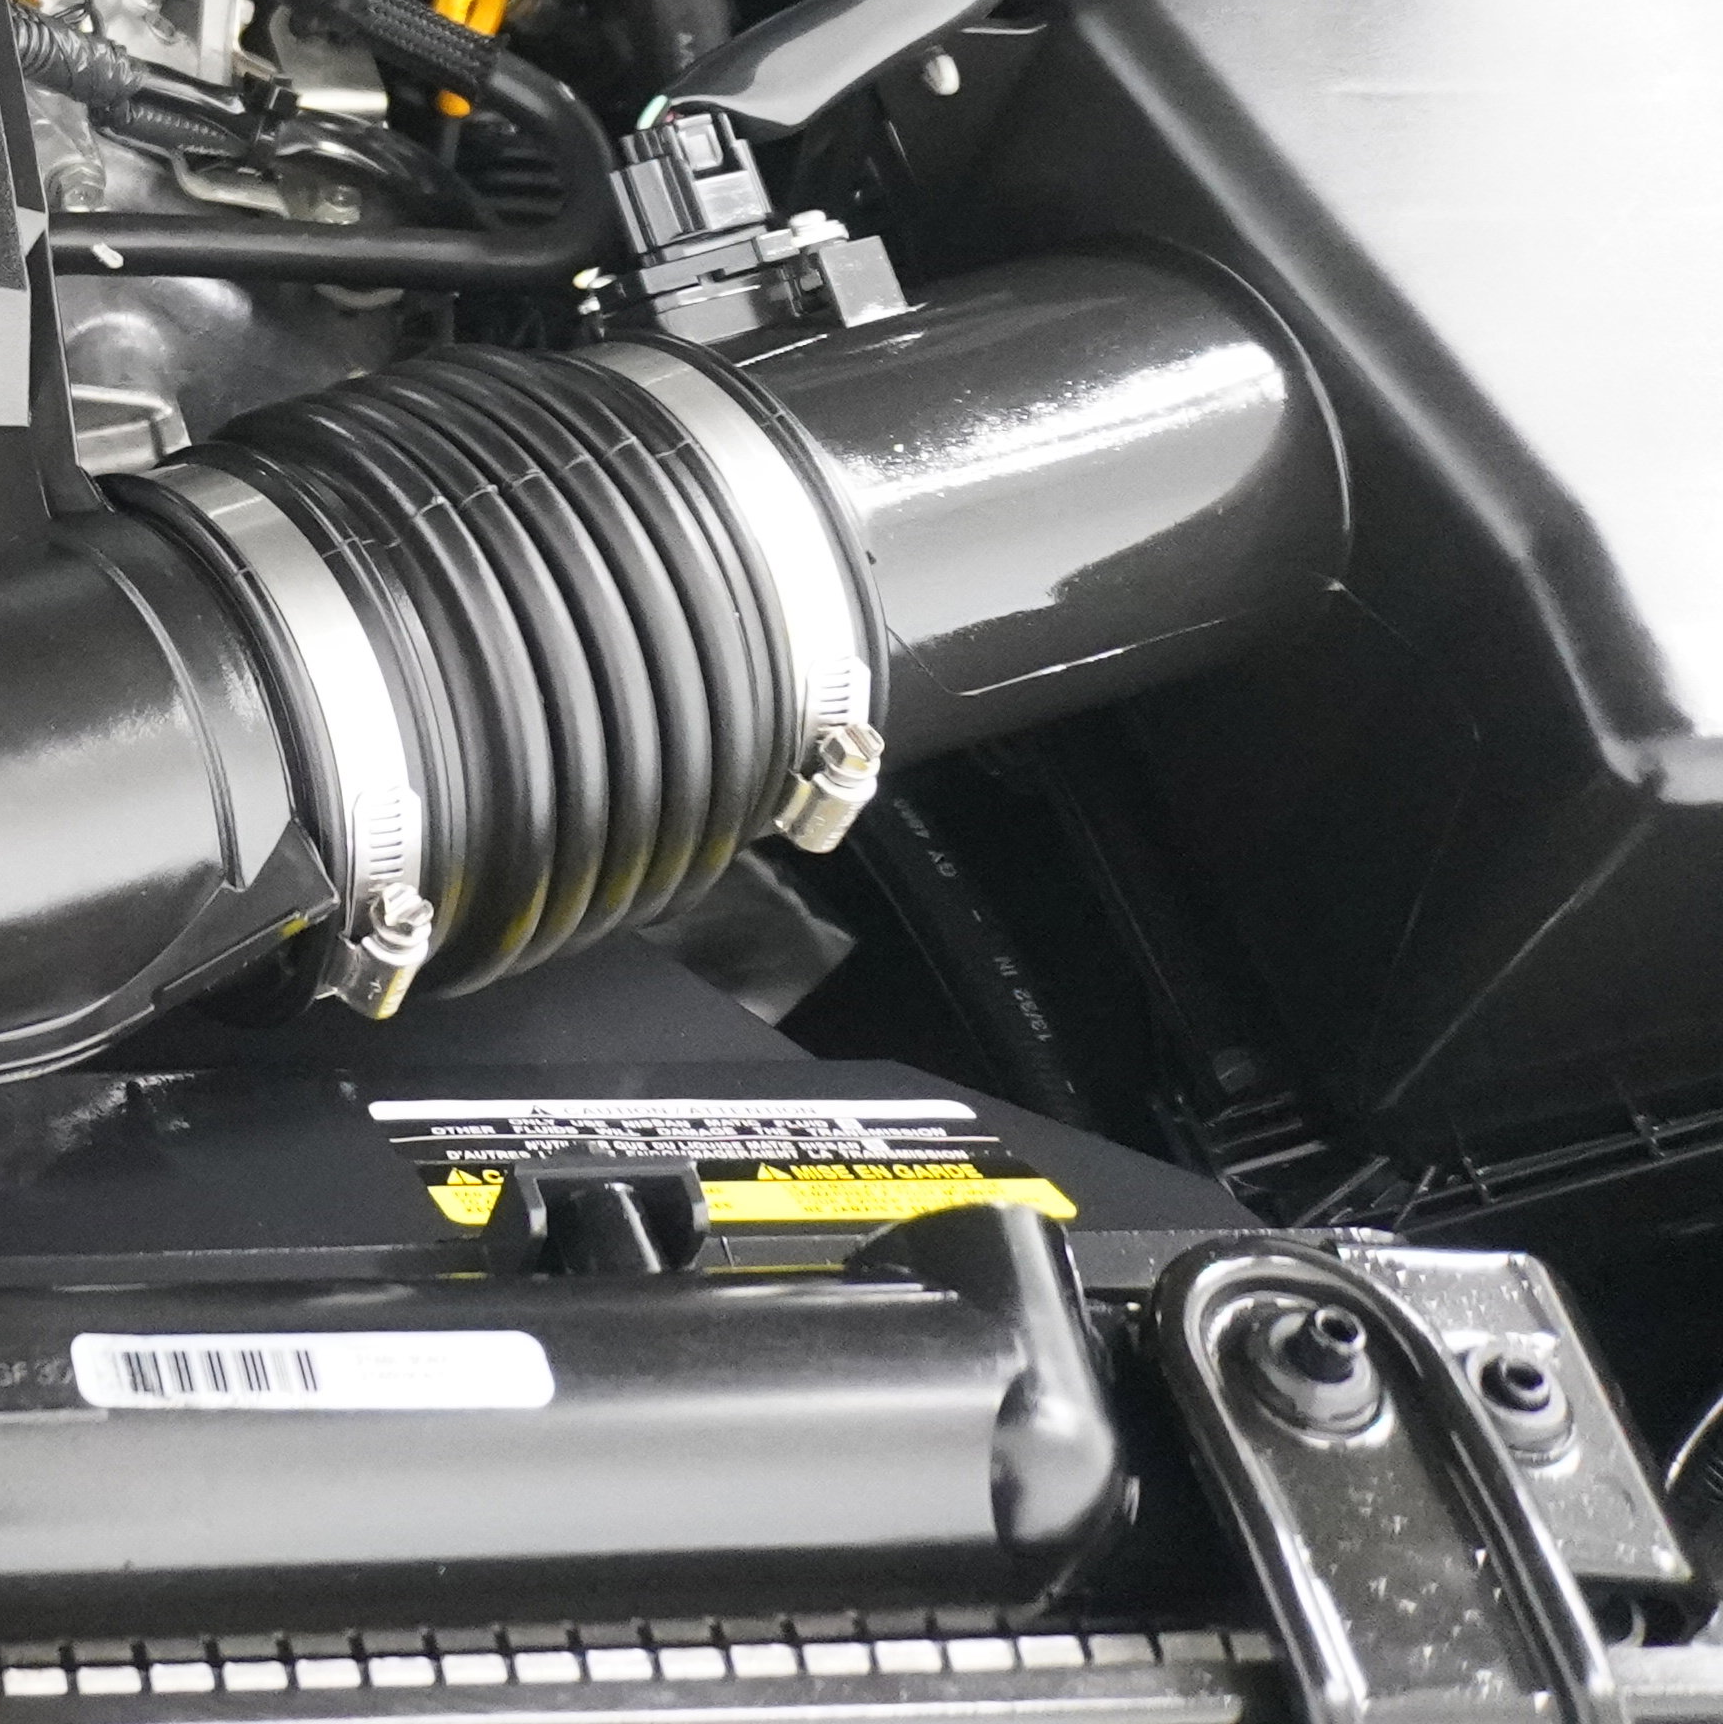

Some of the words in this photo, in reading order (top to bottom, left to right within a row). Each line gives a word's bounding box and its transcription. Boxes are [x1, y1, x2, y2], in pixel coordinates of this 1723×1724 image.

[563, 1106, 667, 1116] CAUTION
[688, 1105, 818, 1115] ATTENTION
[507, 1118, 556, 1126] ONLY
[569, 1119, 609, 1128] USE
[620, 1119, 691, 1128] NISSAN
[703, 1118, 761, 1128] MATIC
[773, 1120, 829, 1128] FLUID
[430, 1125, 496, 1135] OTHER
[513, 1126, 580, 1134] FLUIDS
[594, 1127, 640, 1136] WILL
[656, 1127, 739, 1136] DAMAGE
[755, 1127, 792, 1136] THE
[806, 1128, 947, 1137] TRANSMISSION
[613, 1141, 647, 1151] QUE
[652, 1141, 678, 1150] DU
[744, 1142, 795, 1151] MATIC
[445, 1149, 532, 1161] D'AUTRES
[832, 1151, 971, 1161] TRANSMISSION
[789, 1163, 855, 1180] MISE
[852, 1163, 893, 1180] EN
[892, 1163, 984, 1179] GARDE
